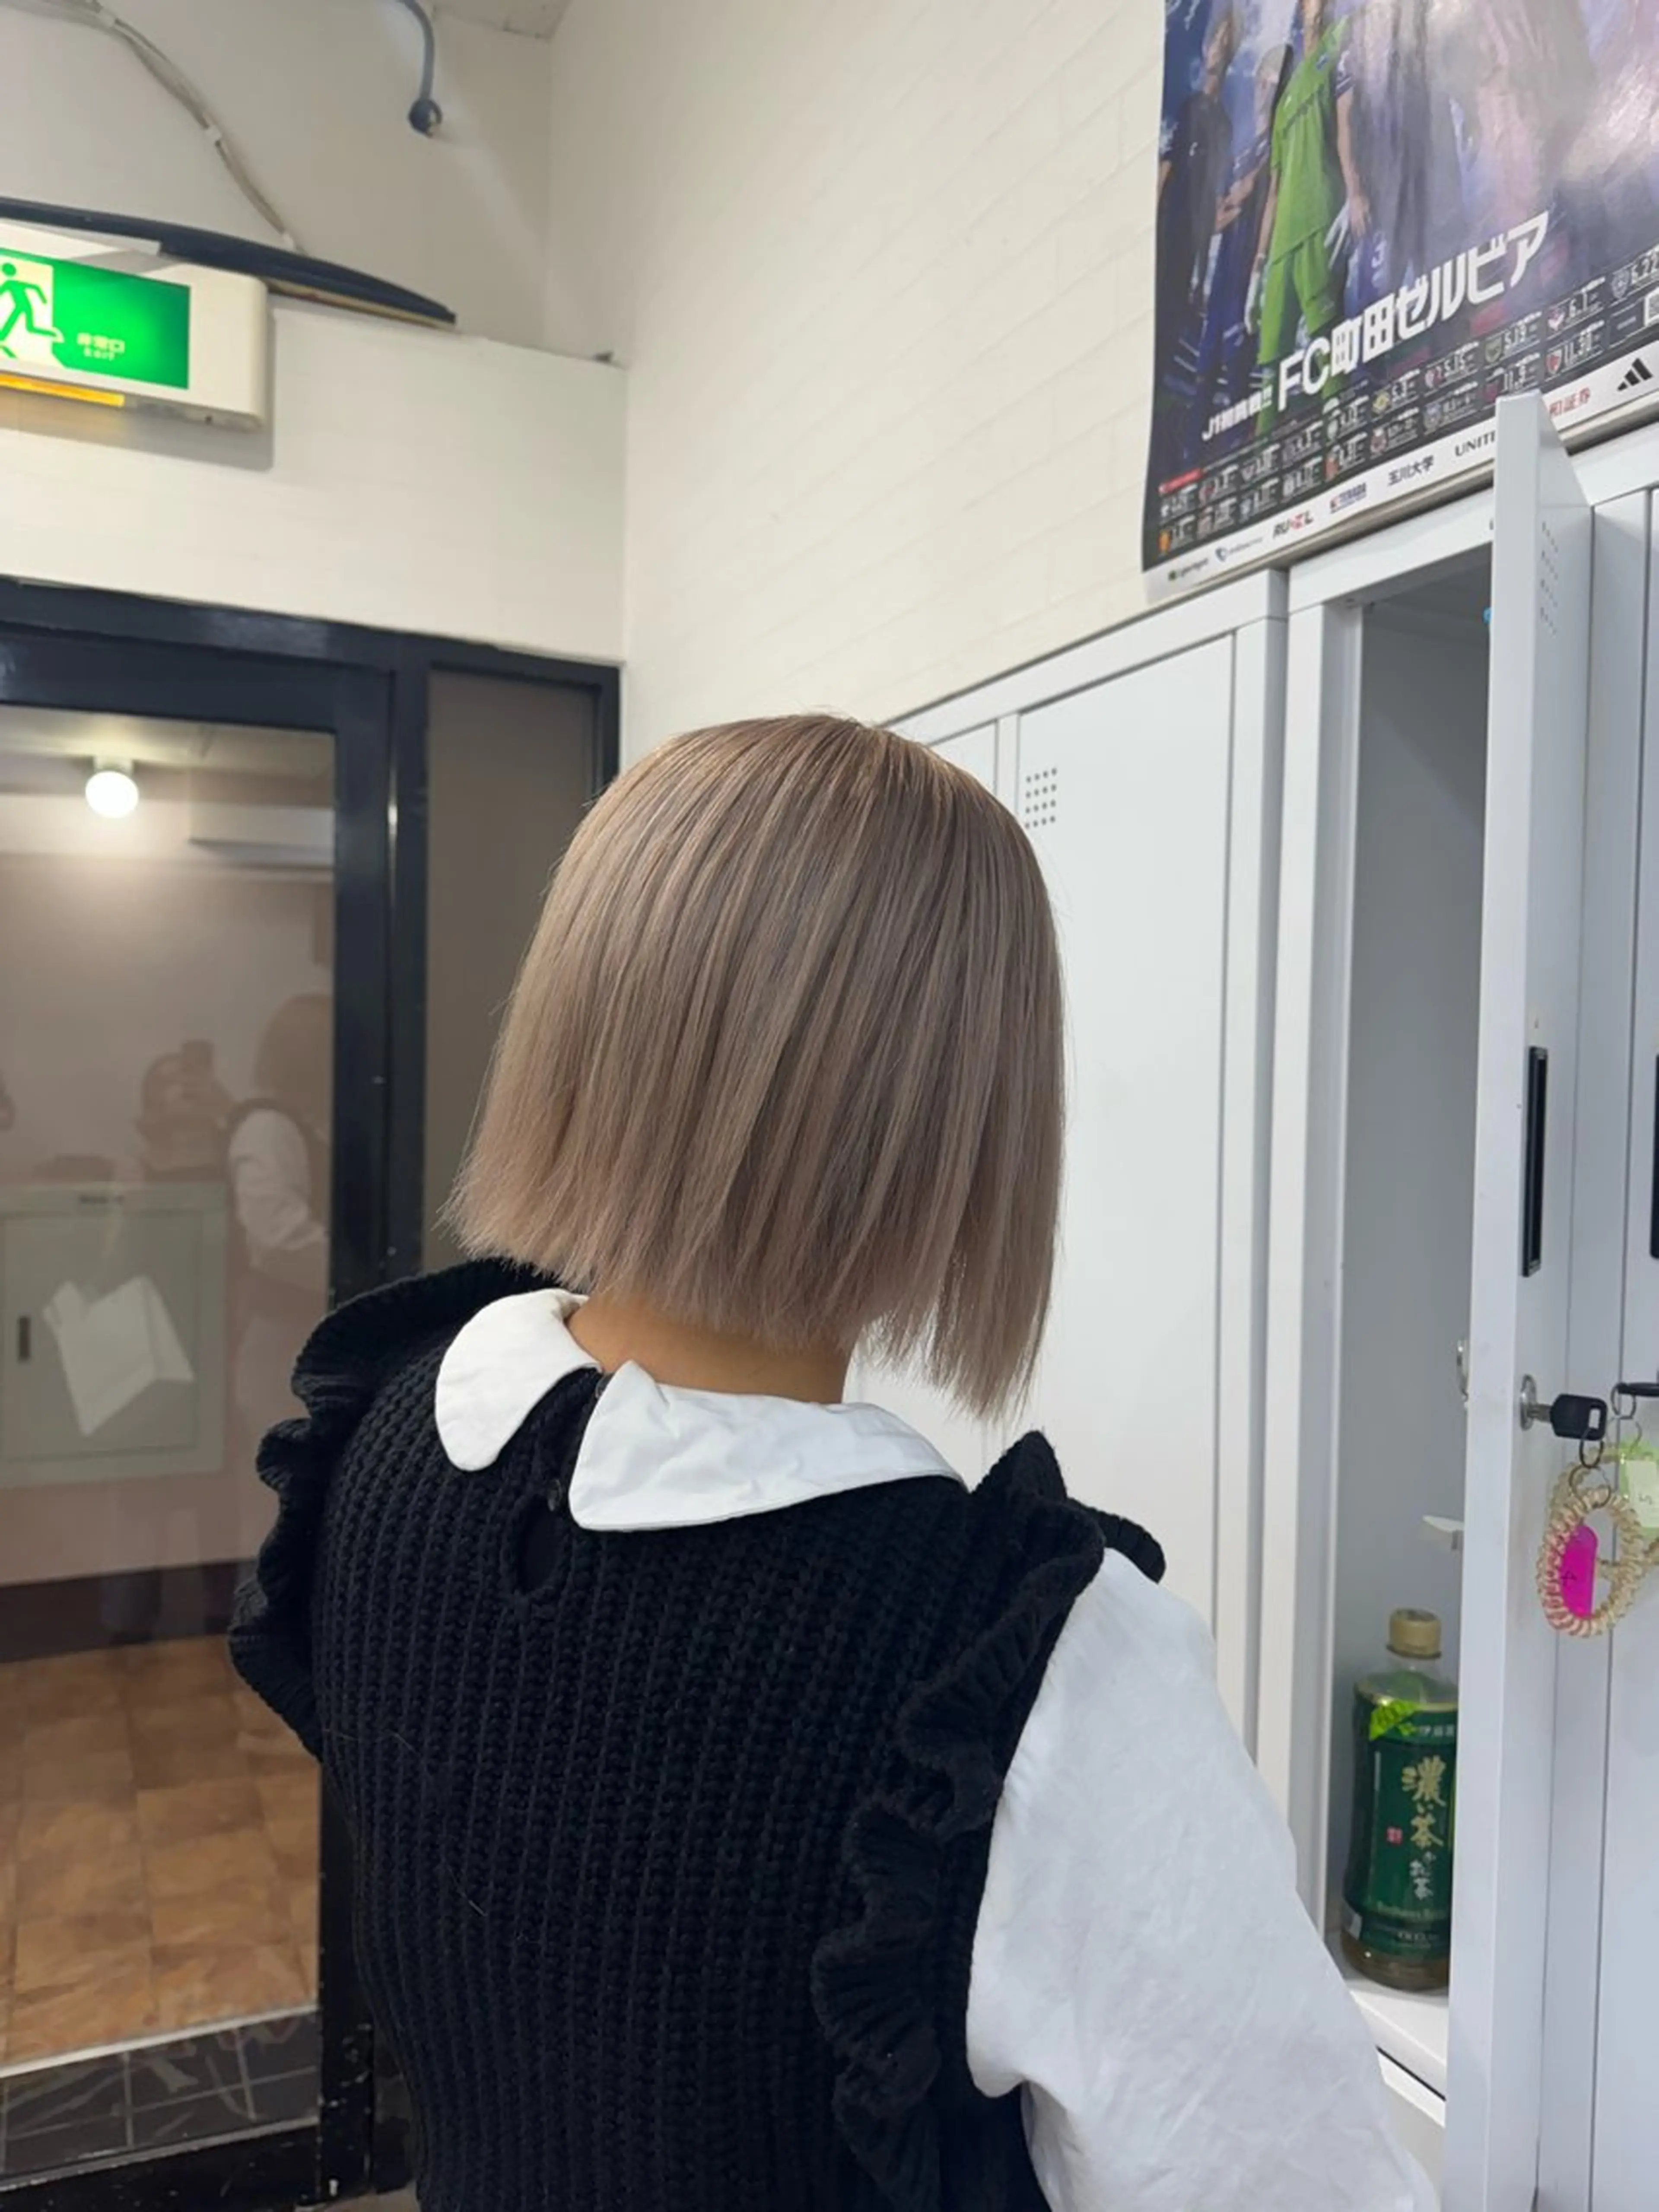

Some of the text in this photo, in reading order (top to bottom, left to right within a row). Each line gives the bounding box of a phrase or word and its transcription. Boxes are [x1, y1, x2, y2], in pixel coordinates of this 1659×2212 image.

[1278, 210, 1549, 412] FC町田ゼルビア
[1387, 455, 1434, 487] 玉川大学
[1402, 1754, 1446, 1849] 濃い茶
